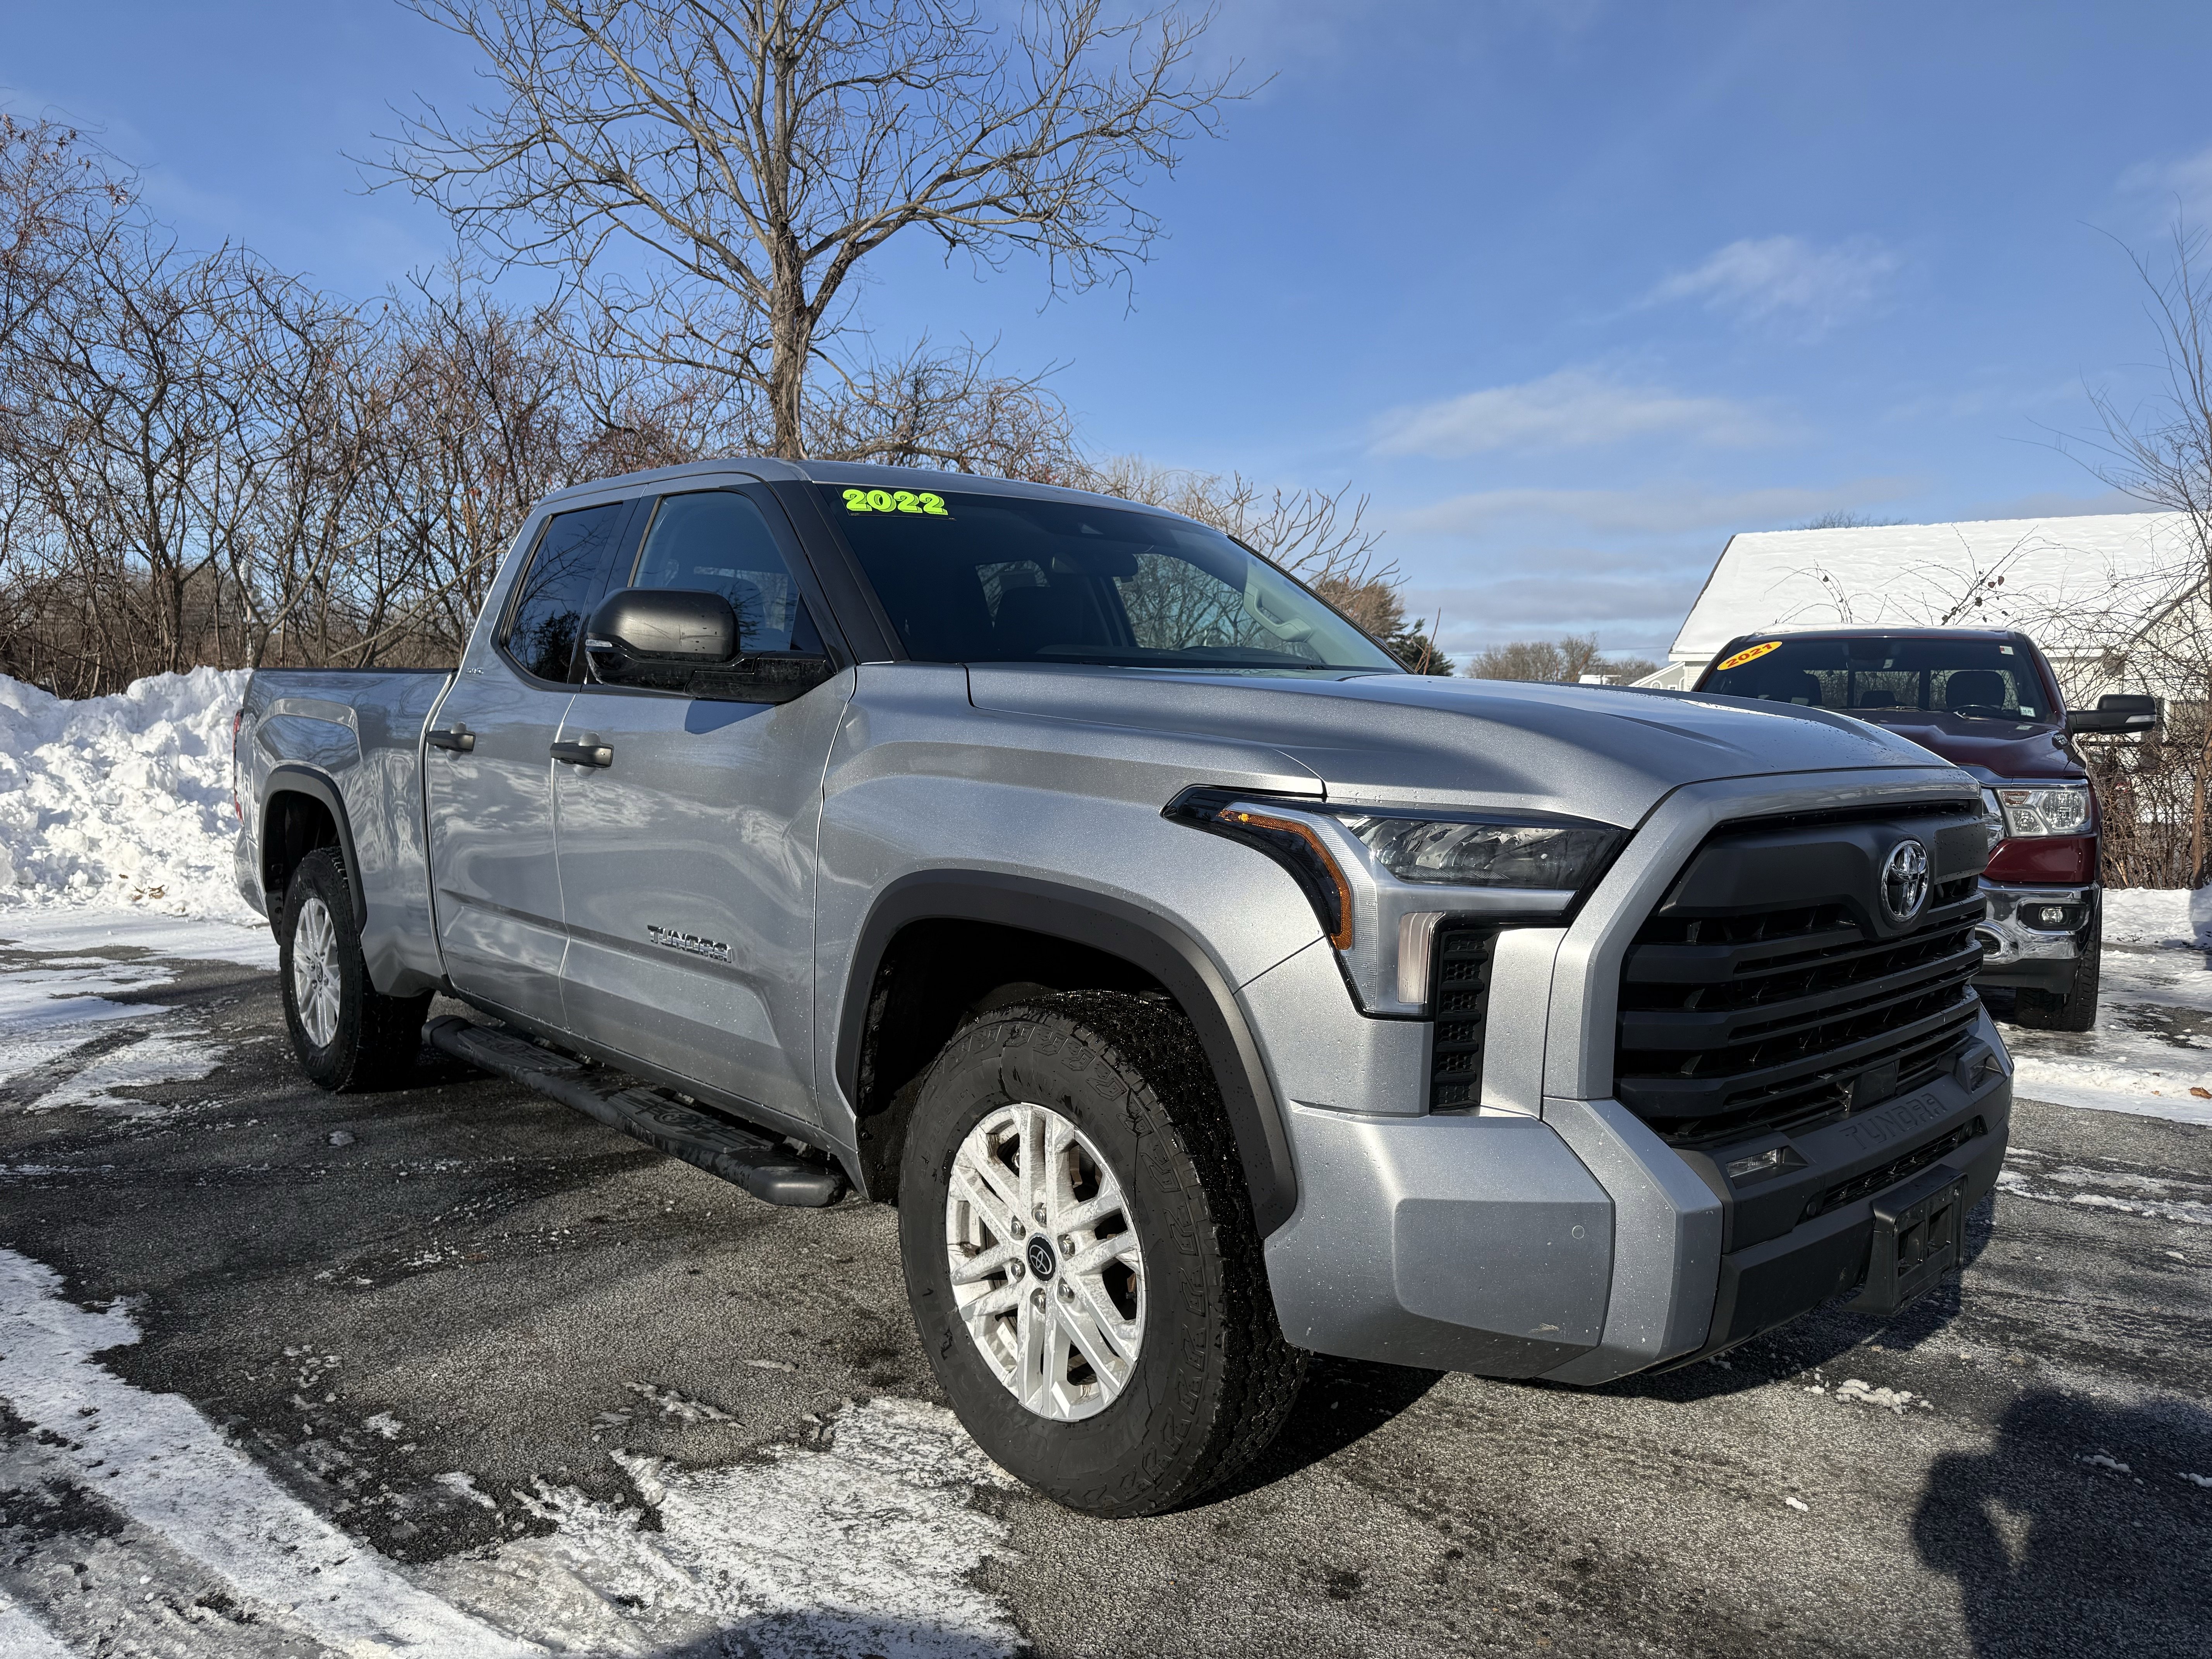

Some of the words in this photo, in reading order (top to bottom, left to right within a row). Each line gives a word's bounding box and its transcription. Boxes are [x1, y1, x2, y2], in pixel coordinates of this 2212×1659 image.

[842, 489, 948, 515] 2022
[1726, 644, 1772, 668] 2021
[647, 924, 733, 963] TUNDRA
[1839, 1092, 1948, 1150] TUNDRA
